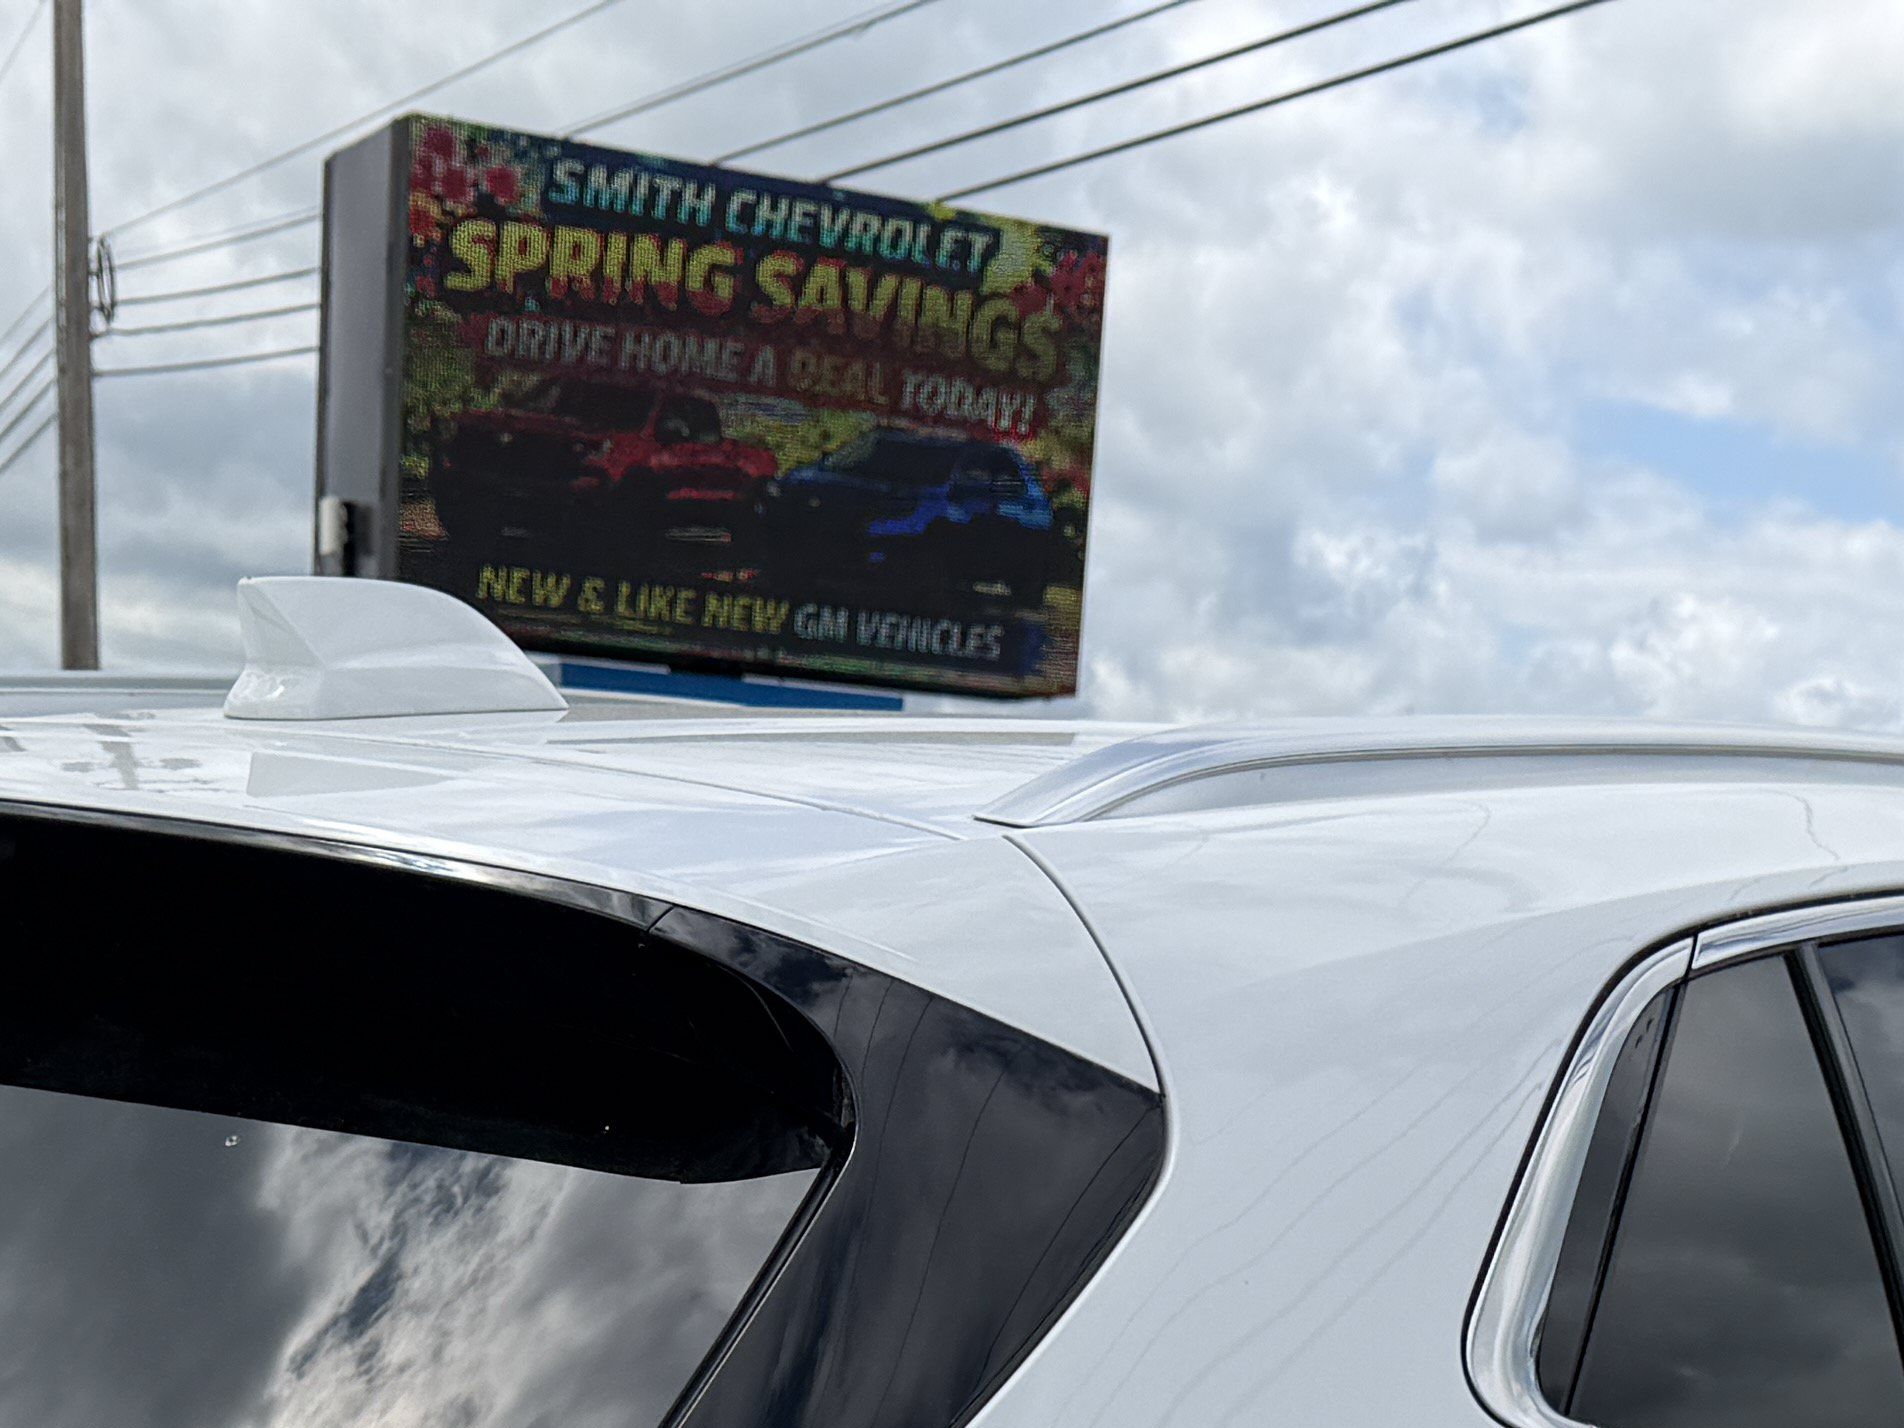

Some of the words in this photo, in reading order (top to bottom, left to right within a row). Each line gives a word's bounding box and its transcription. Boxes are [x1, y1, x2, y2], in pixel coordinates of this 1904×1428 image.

[445, 218, 741, 316] SPRING
[549, 159, 716, 228] SMITH
[725, 188, 995, 274] CHEVROLET
[485, 316, 616, 366] DRIVE
[621, 328, 746, 383] HOME
[749, 344, 777, 388] A
[901, 367, 1036, 435] TODAY!
[477, 563, 571, 609] NEW
[613, 577, 696, 625] LIKE
[701, 590, 791, 635] NEW
[794, 602, 850, 643] GM
[855, 609, 1004, 661] VEHICLES
